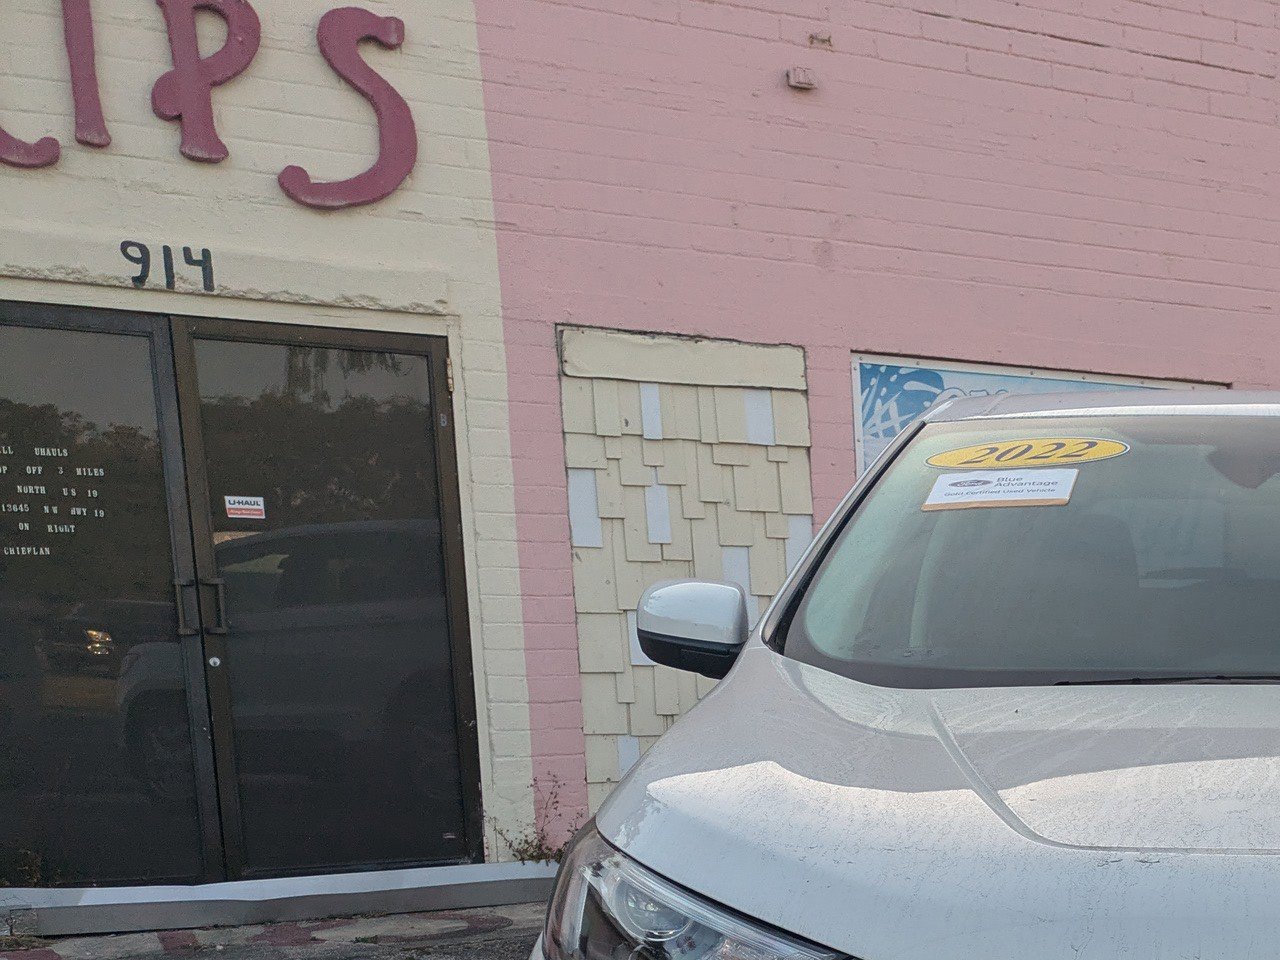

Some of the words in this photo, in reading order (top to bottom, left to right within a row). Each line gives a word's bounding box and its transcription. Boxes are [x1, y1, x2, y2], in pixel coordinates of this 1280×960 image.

[0, 0, 418, 210] IPS
[120, 239, 216, 292] 914
[0, 446, 14, 455] LL
[34, 447, 69, 457] UHAULS
[957, 440, 1099, 466] 2022
[26, 465, 43, 475] OFF
[76, 467, 105, 477] MILES
[993, 480, 1059, 488] Advantage
[17, 485, 46, 495] NORTH
[228, 499, 261, 507] U-HAUL
[18, 522, 30, 531] ON
